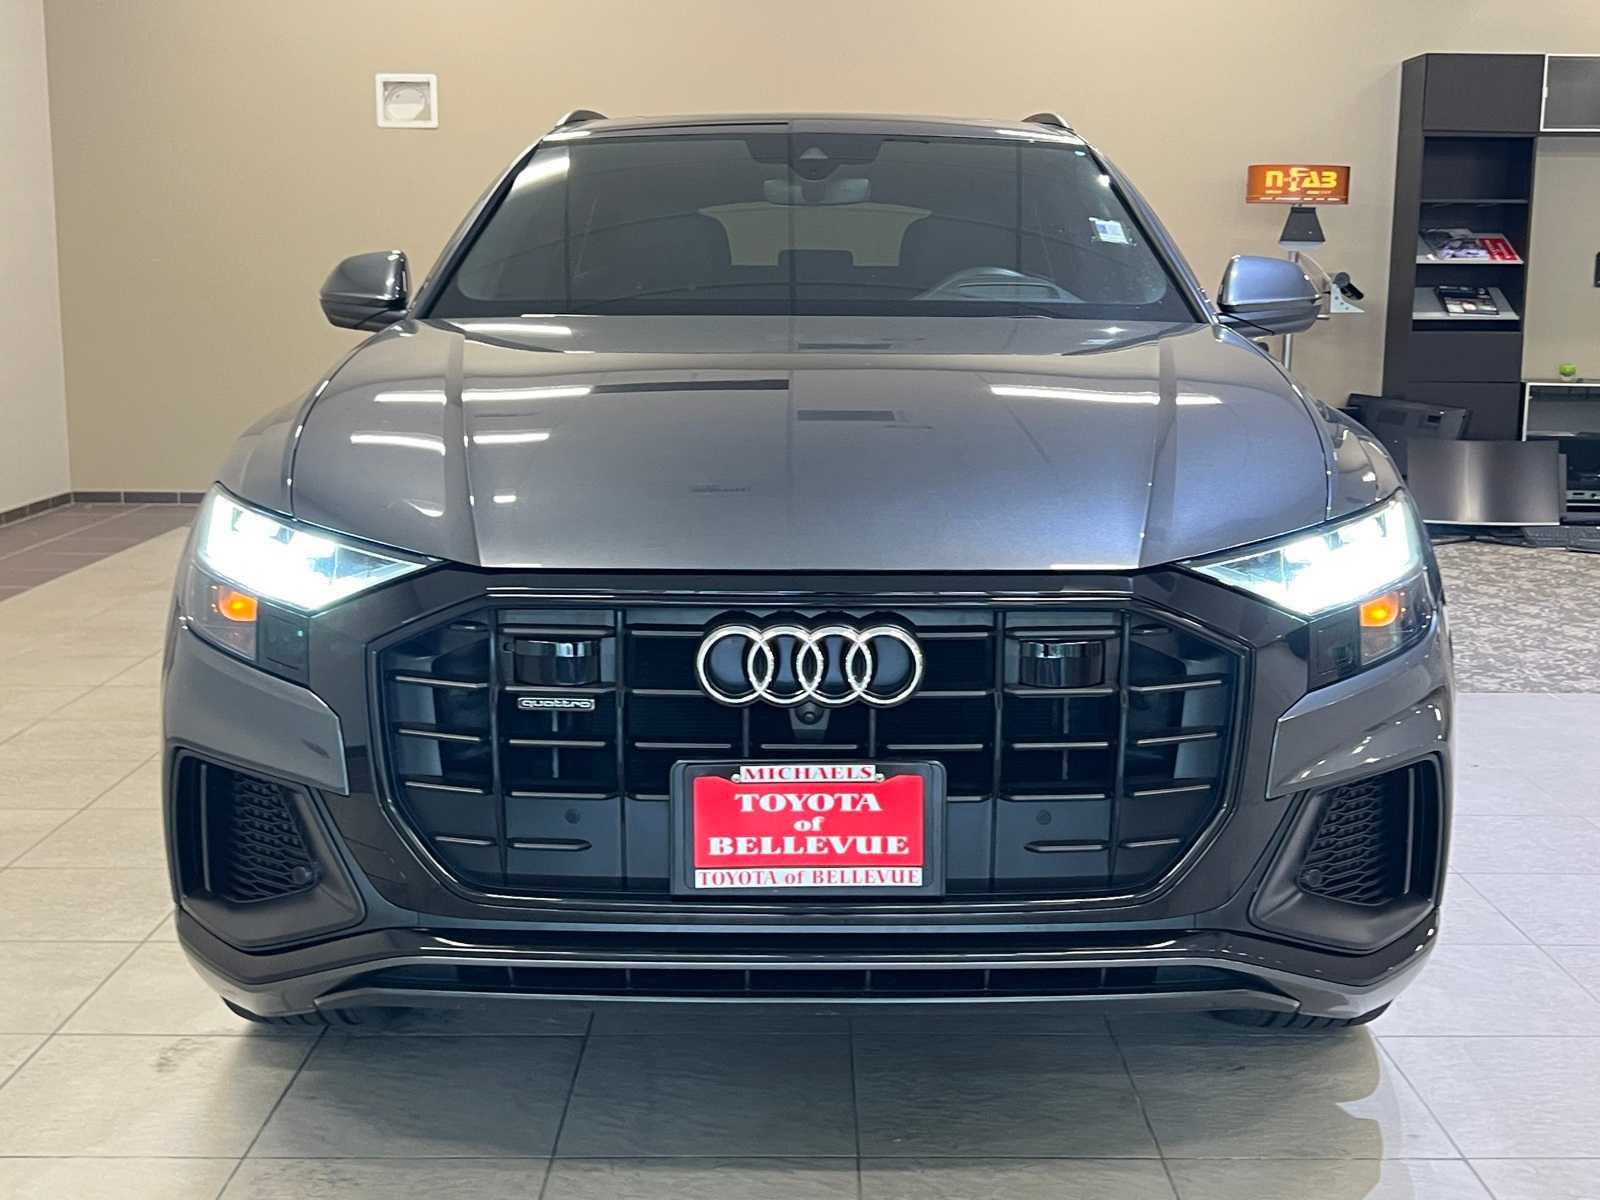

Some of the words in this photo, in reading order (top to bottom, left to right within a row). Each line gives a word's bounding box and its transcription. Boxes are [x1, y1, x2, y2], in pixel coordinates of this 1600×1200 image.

[522, 699, 591, 709] quattro
[745, 766, 872, 780] MICHAELS
[735, 793, 882, 812] TOYOTA
[793, 816, 824, 832] of
[708, 836, 909, 855] BELLEVUE
[700, 871, 777, 886] TOYOTA
[785, 870, 805, 885] of
[812, 870, 919, 884] BELLEVUE
